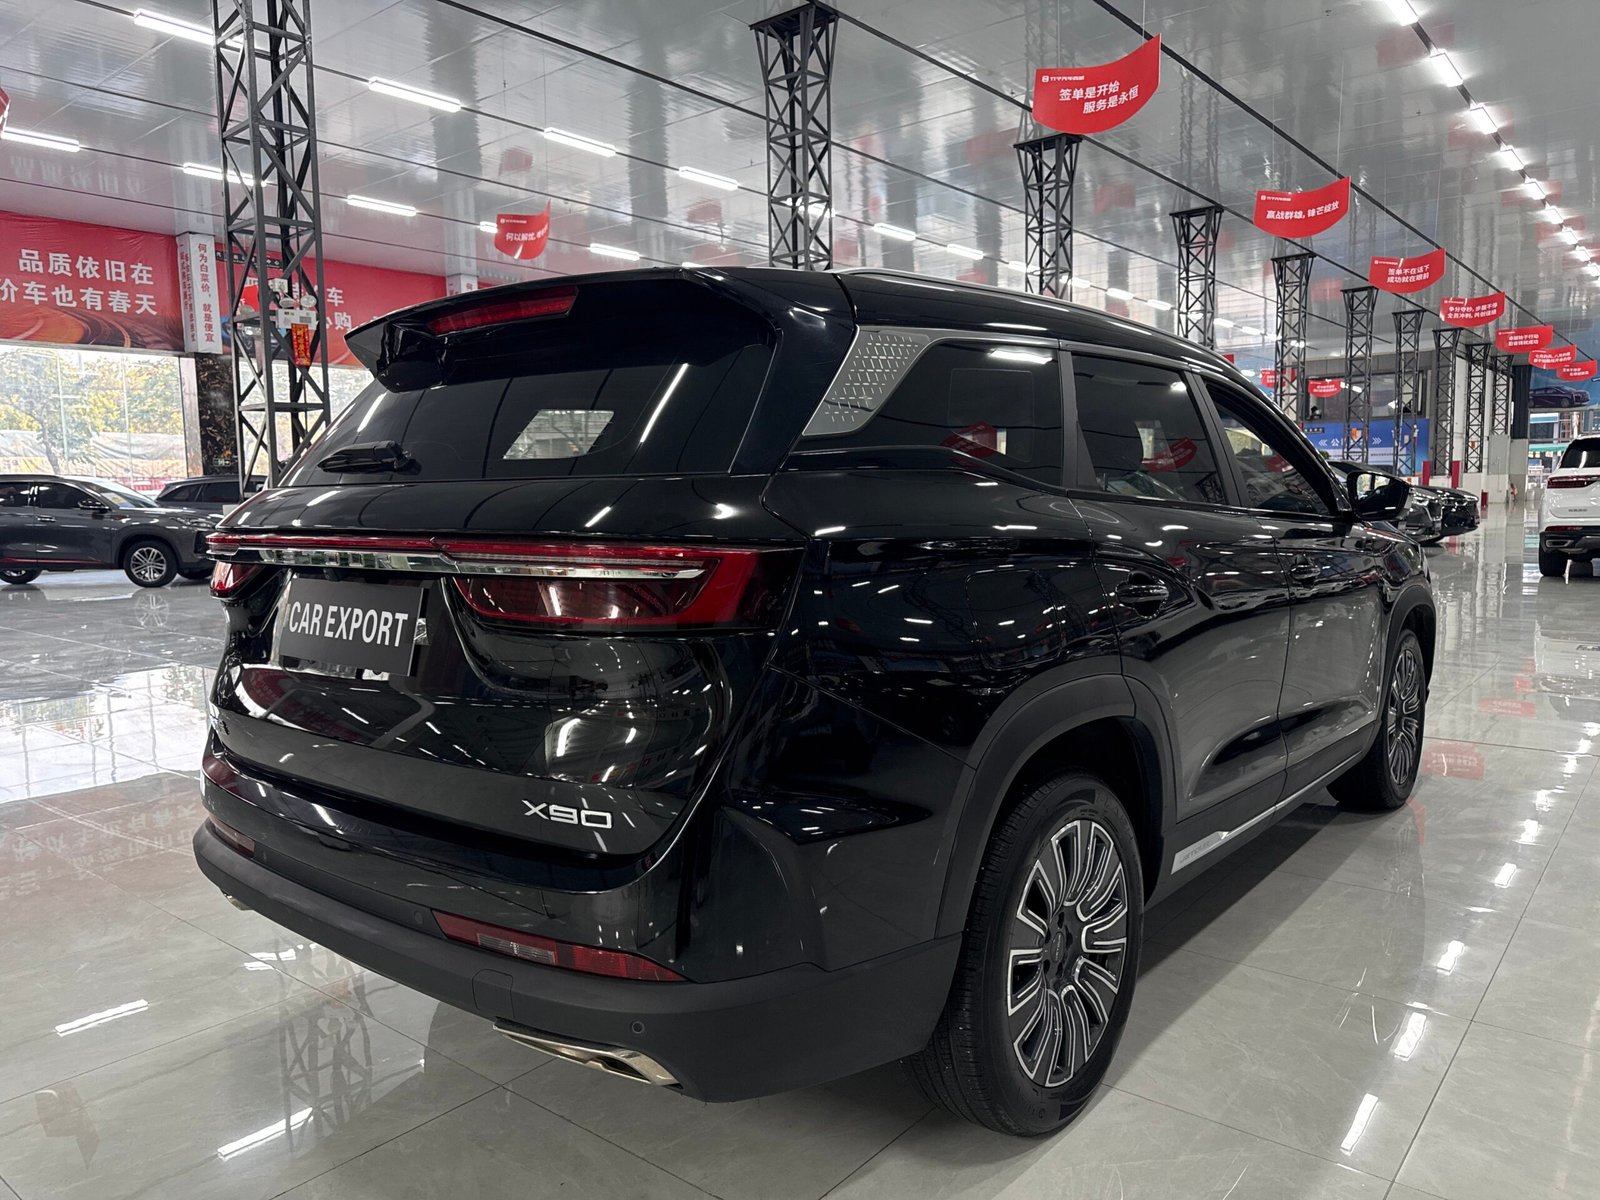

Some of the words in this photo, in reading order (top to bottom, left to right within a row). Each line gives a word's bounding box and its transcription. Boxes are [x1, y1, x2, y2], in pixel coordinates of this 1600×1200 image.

[1059, 80, 1120, 101] 签单是开始
[1083, 85, 1139, 114] 服务是永恒
[18, 248, 154, 285] 品质依旧在
[1386, 272, 1430, 284] 成功就在眼前
[1387, 264, 1430, 276] 签单不在话下
[0, 277, 158, 315] 价车也有春天
[288, 601, 324, 637] CAR
[323, 604, 409, 648] EXPORT
[521, 799, 613, 829] X90
